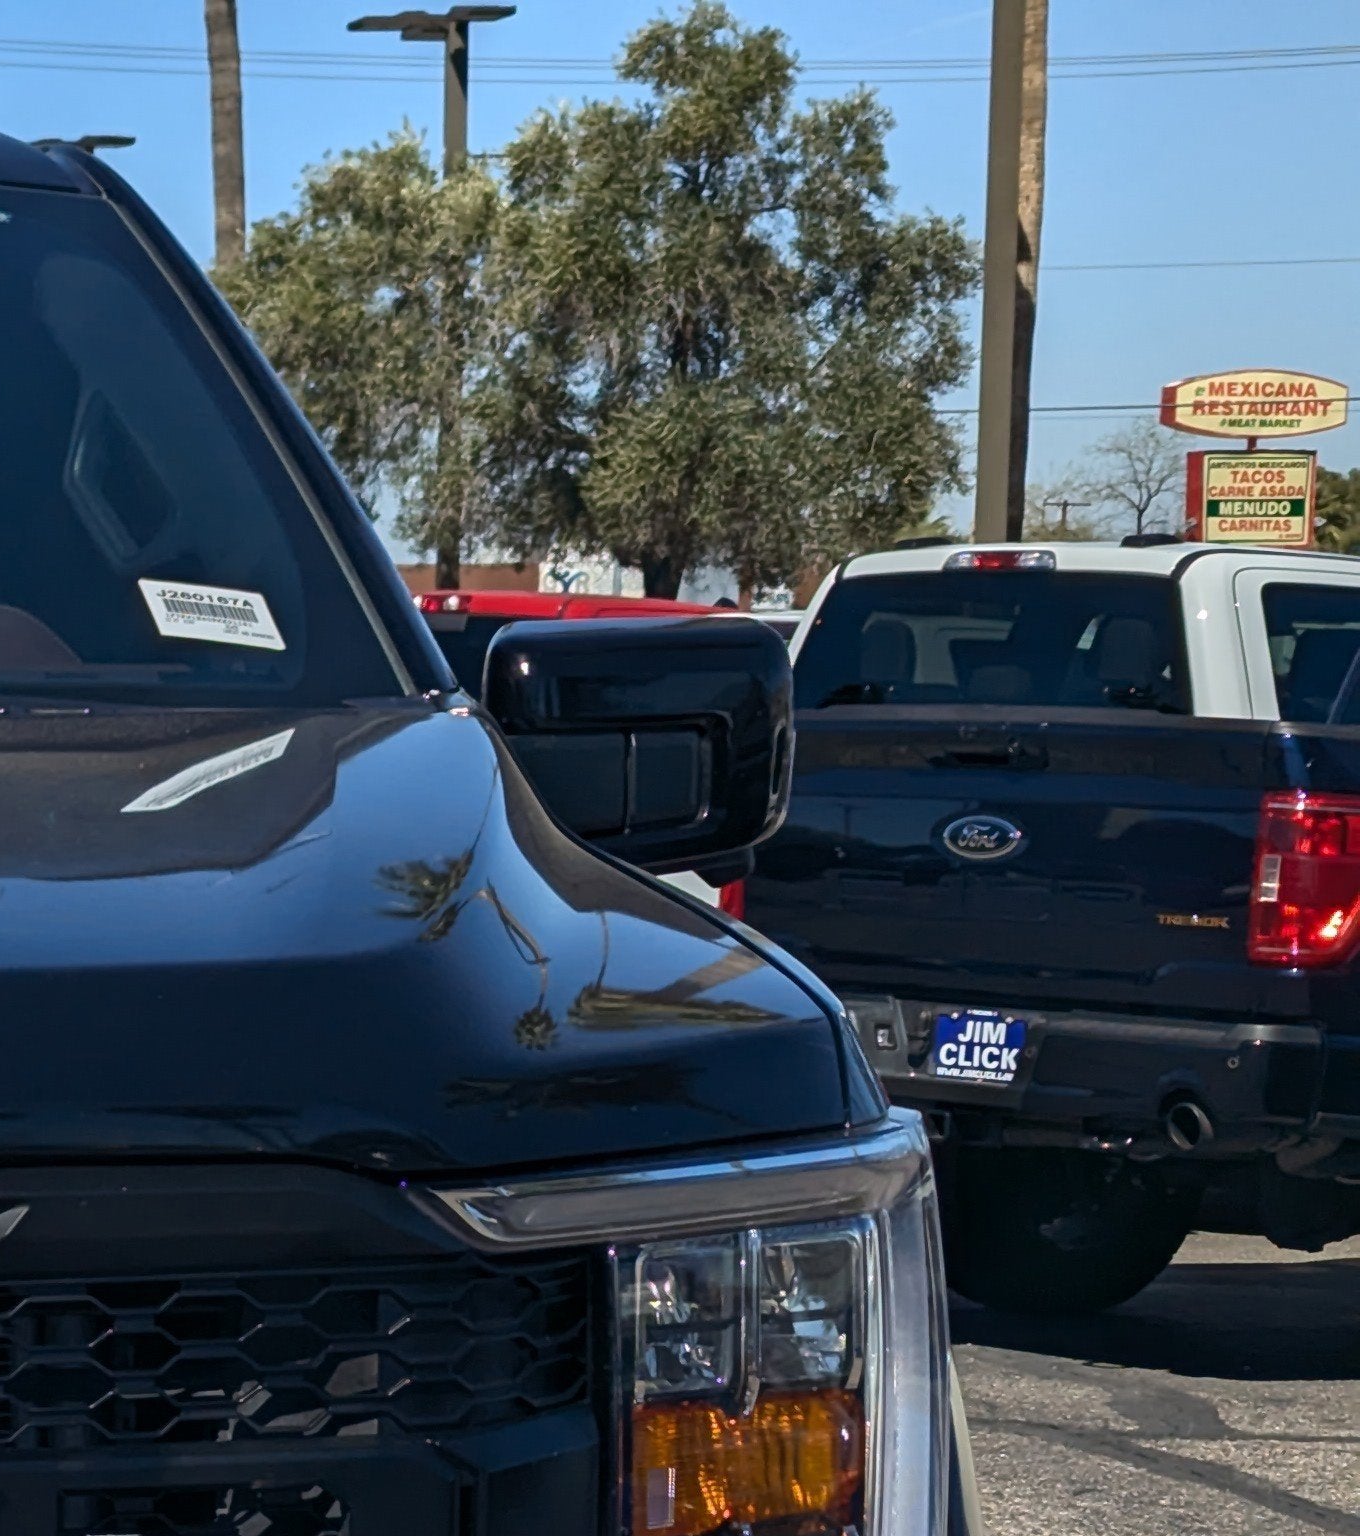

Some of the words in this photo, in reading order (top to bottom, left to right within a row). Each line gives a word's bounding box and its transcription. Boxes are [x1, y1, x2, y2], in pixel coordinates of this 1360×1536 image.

[1208, 382, 1318, 398] MEXICANA
[1192, 400, 1331, 417] RESTAURANT
[1230, 470, 1286, 484] TACOS
[1209, 485, 1255, 498] CARNE
[1258, 485, 1304, 498] ASADA
[1218, 501, 1292, 516] MENUDO
[1218, 519, 1292, 532] CARNITAS
[957, 1019, 1007, 1046] JIM
[939, 1042, 1020, 1071] CLICK
